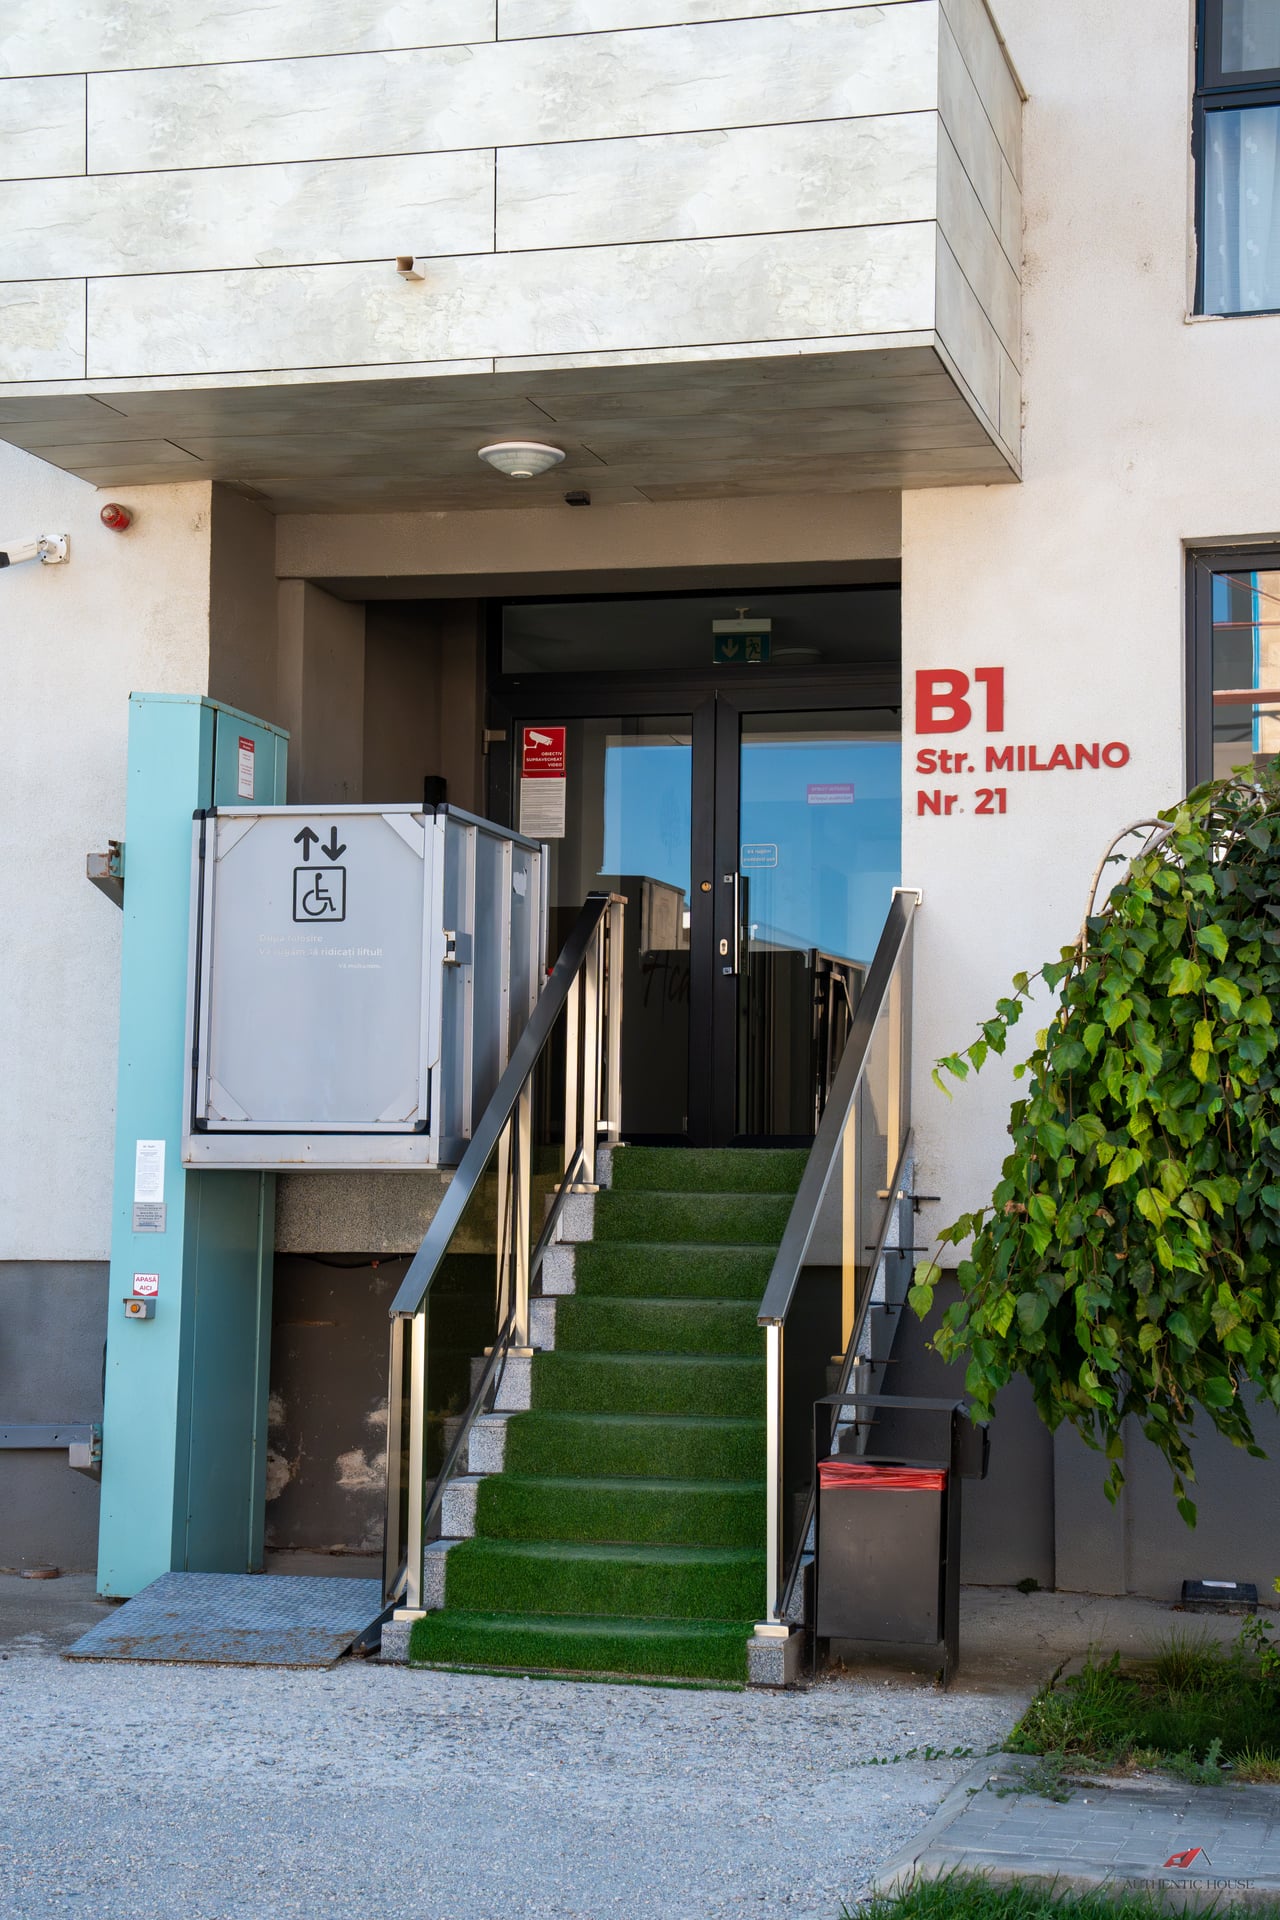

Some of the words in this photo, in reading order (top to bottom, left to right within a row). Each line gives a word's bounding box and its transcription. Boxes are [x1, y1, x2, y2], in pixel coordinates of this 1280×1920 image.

[915, 667, 1004, 734] B1
[916, 748, 975, 775] Str.
[985, 742, 1130, 772] MILANO
[975, 788, 1007, 815] 21
